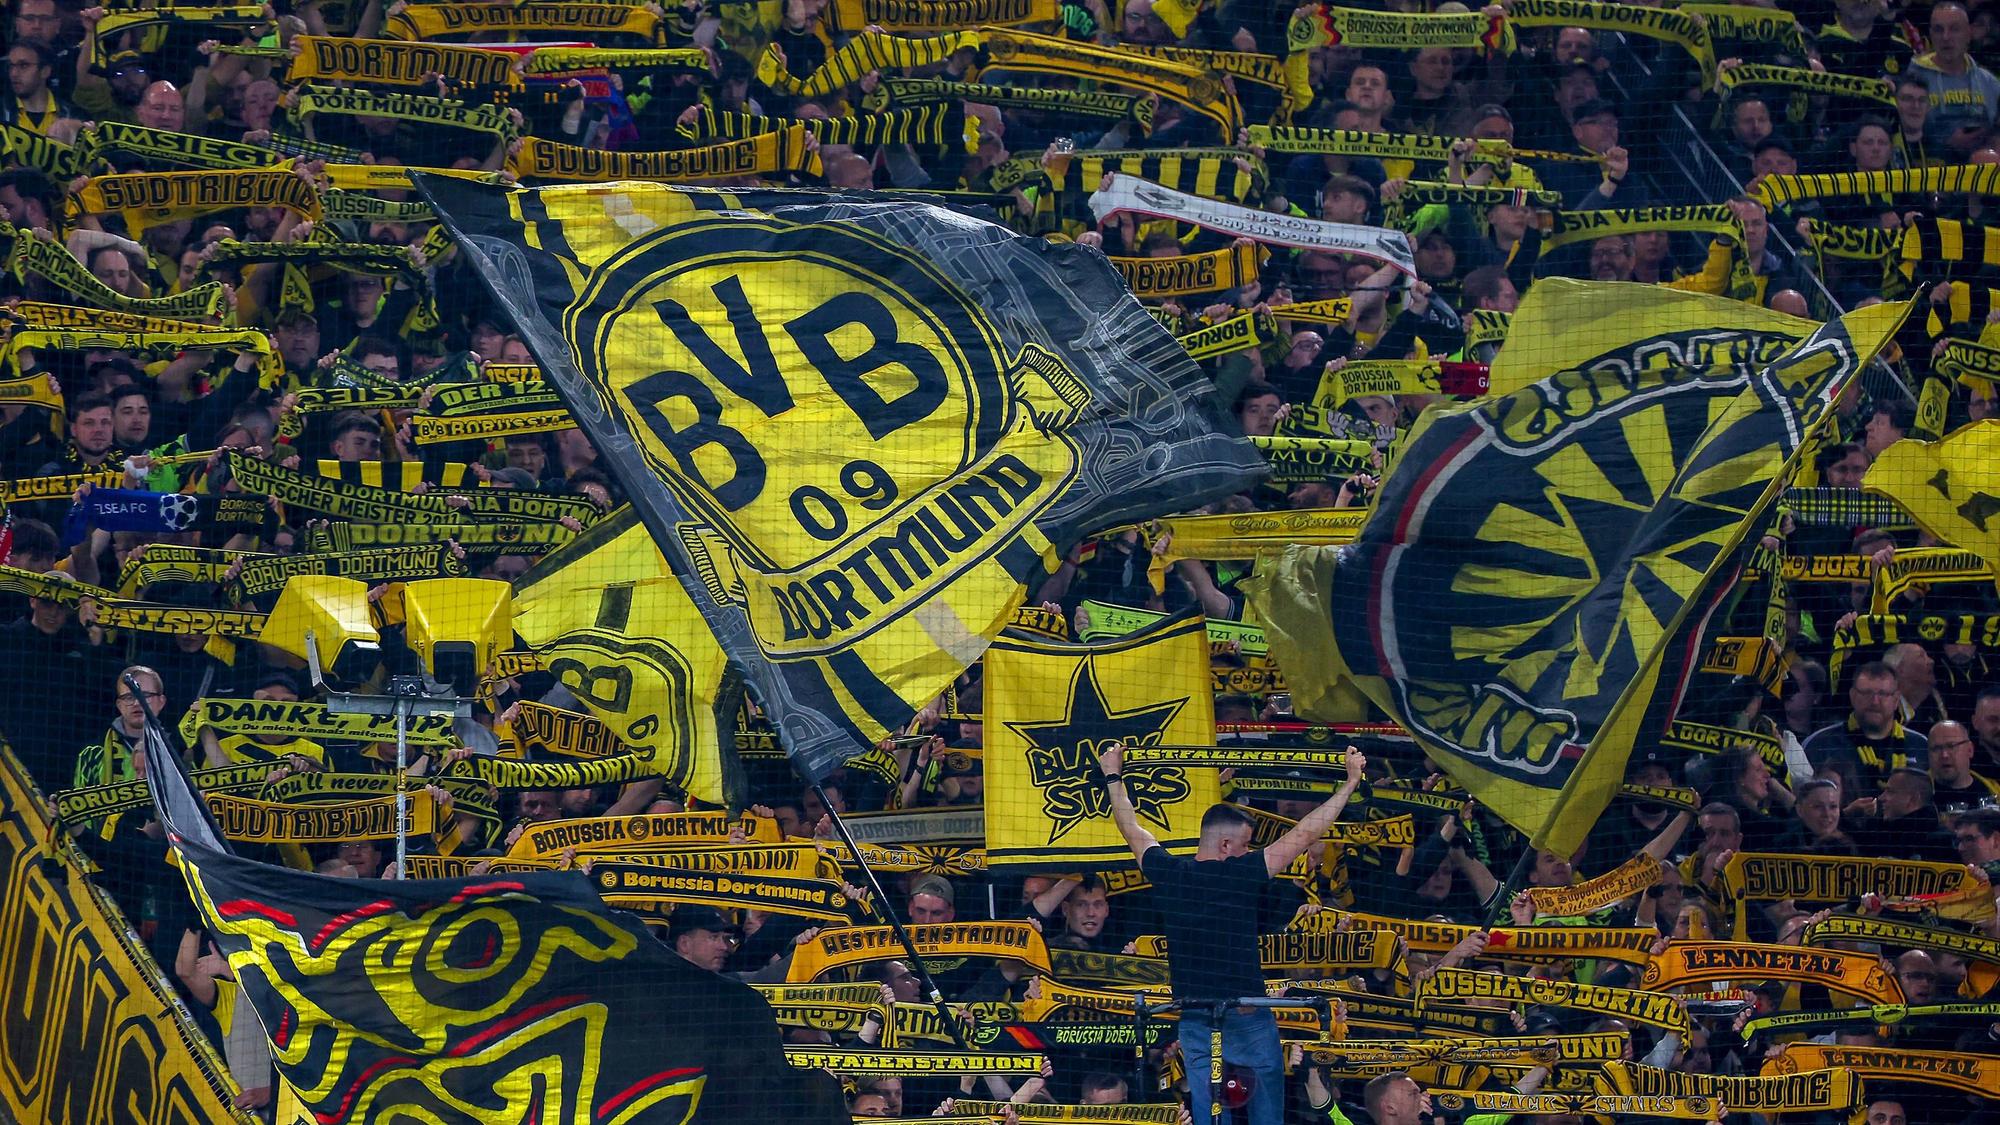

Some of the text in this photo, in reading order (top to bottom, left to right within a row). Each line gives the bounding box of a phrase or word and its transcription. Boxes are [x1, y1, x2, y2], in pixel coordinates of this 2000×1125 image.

[315, 41, 518, 83] DORTMUND
[311, 94, 468, 123] DORTMUNDER
[1341, 370, 1394, 384] BORUSSIA
[1344, 380, 1400, 396] DORTMUND
[441, 382, 503, 406] DER
[622, 274, 949, 513] BVB
[231, 451, 449, 512] BORUSSIA DORTMUN
[131, 502, 147, 515] FC
[339, 499, 413, 523] MEISTER
[789, 460, 898, 541] 09
[339, 550, 438, 576] DORTMUND
[771, 453, 1043, 642] DORTMUND
[242, 559, 326, 589] BORUSSIA
[1029, 731, 1162, 781] BLAK
[478, 758, 578, 789] BORUSSIA
[1235, 778, 1311, 791] SUPPORTERS
[531, 820, 626, 853] BORUSSIA
[651, 816, 757, 839] DORTMUD
[623, 870, 825, 904] Borussia Dortmund
[1745, 857, 1965, 898] SÜDTRIBÜNE
[1681, 946, 1846, 979] LENNETAL
[1105, 1029, 1158, 1044] DORTMND
[1820, 1048, 1982, 1083] LENNETAL
